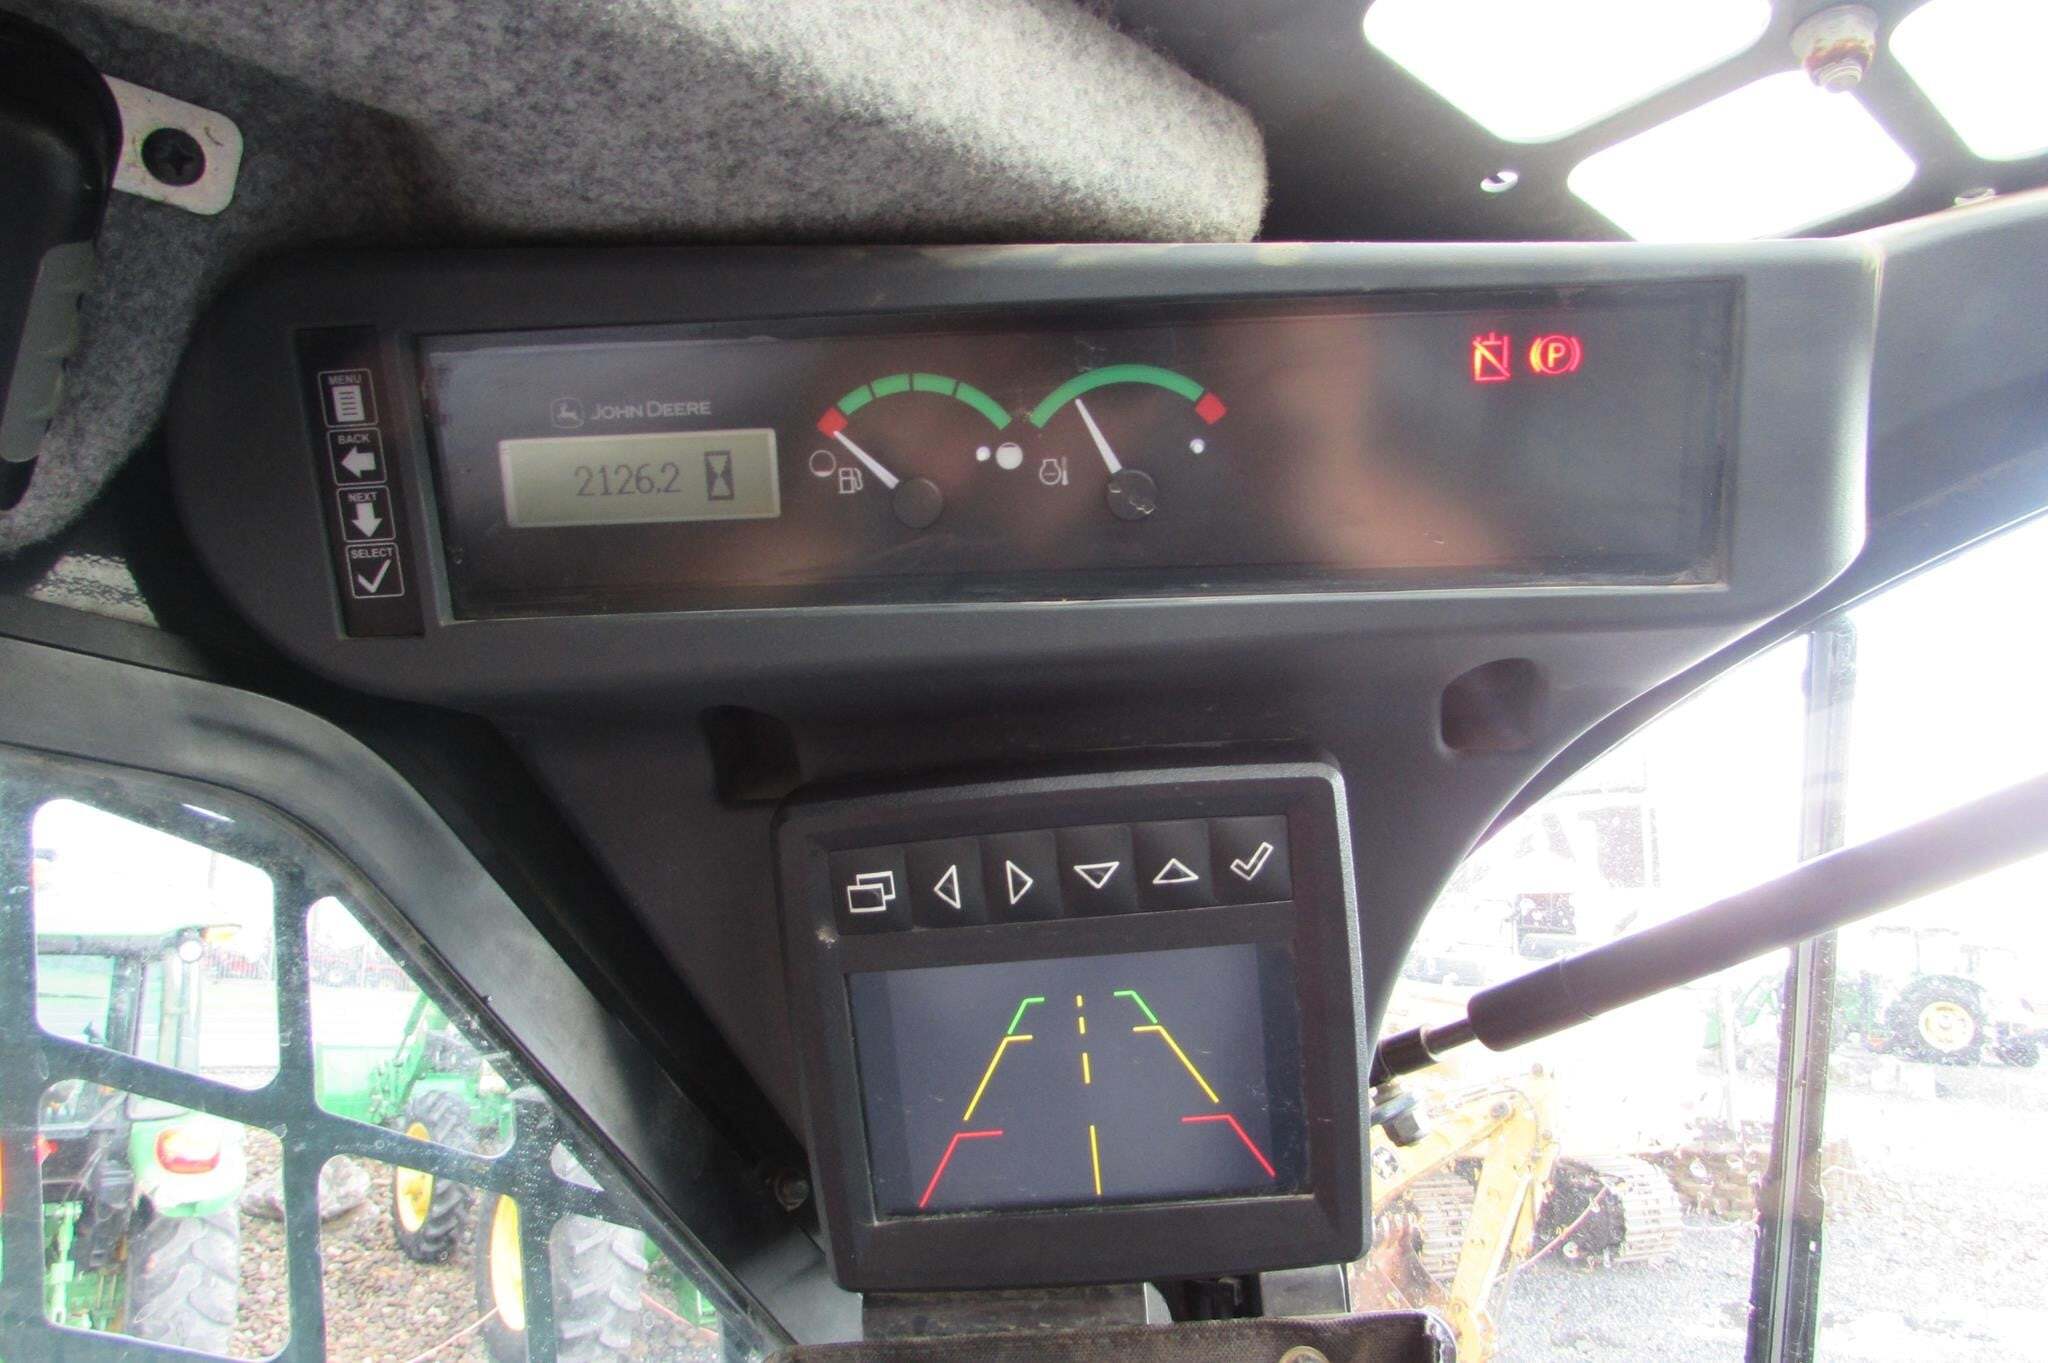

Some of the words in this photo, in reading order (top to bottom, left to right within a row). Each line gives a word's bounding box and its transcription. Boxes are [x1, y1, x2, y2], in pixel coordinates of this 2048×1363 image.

[328, 374, 362, 385] MENU
[590, 404, 644, 421] JOHN
[646, 400, 711, 417] DEERE
[337, 434, 371, 445] BACK
[574, 462, 681, 497] 2126.2
[347, 491, 378, 502] NEXT
[350, 547, 393, 559] SELECT
